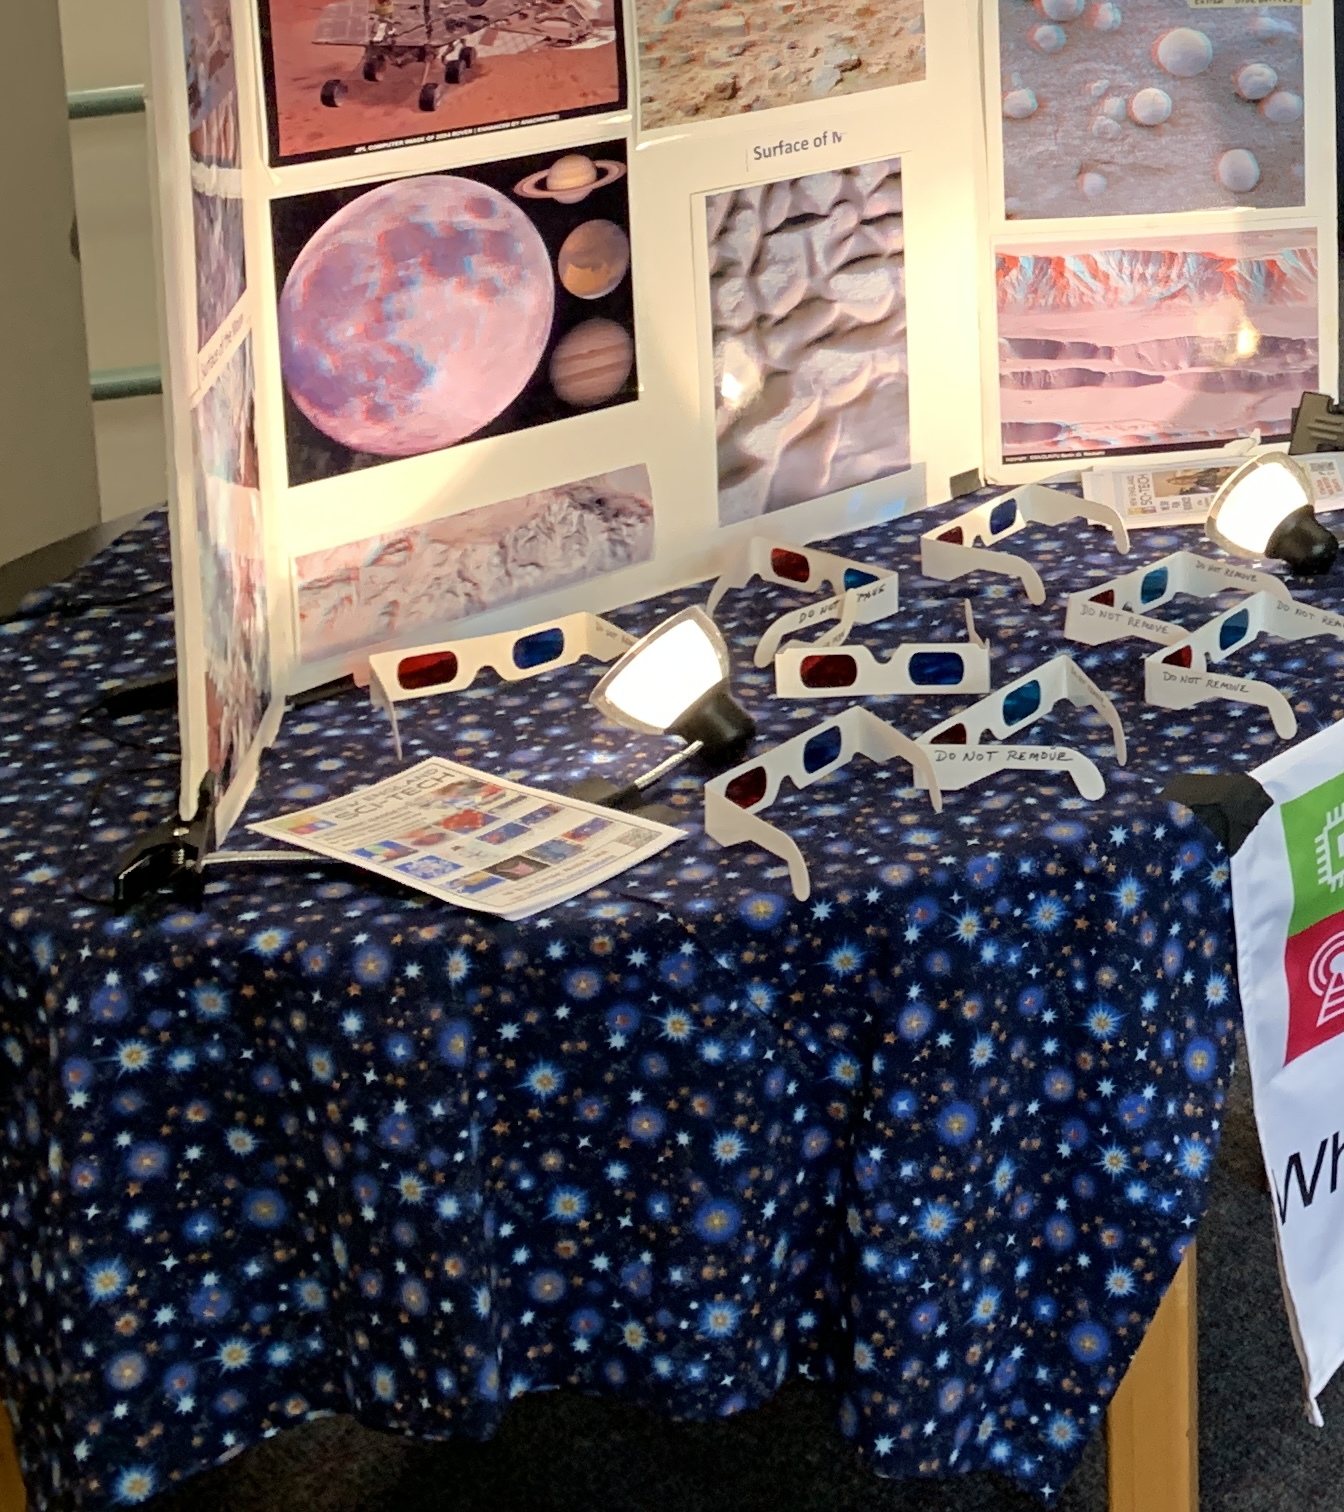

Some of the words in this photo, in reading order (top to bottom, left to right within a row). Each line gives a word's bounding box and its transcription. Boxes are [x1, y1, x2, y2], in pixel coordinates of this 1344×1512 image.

[753, 139, 809, 161] Surface
[813, 131, 828, 148] of
[1224, 568, 1257, 582] REMOVE
[799, 609, 816, 624] DO
[1080, 604, 1095, 616] DO
[1098, 609, 1123, 622] NOT
[1127, 616, 1169, 634] REMOVE
[1276, 600, 1290, 612] DO
[1295, 608, 1315, 620] NOT
[1161, 671, 1177, 681] DO
[1180, 675, 1202, 685] NOT
[1206, 679, 1251, 693] REMOVE
[934, 749, 957, 762] DO
[962, 750, 999, 762] NOT
[1006, 749, 1074, 762] REMOVE
[334, 771, 455, 821] SCI-TECH
